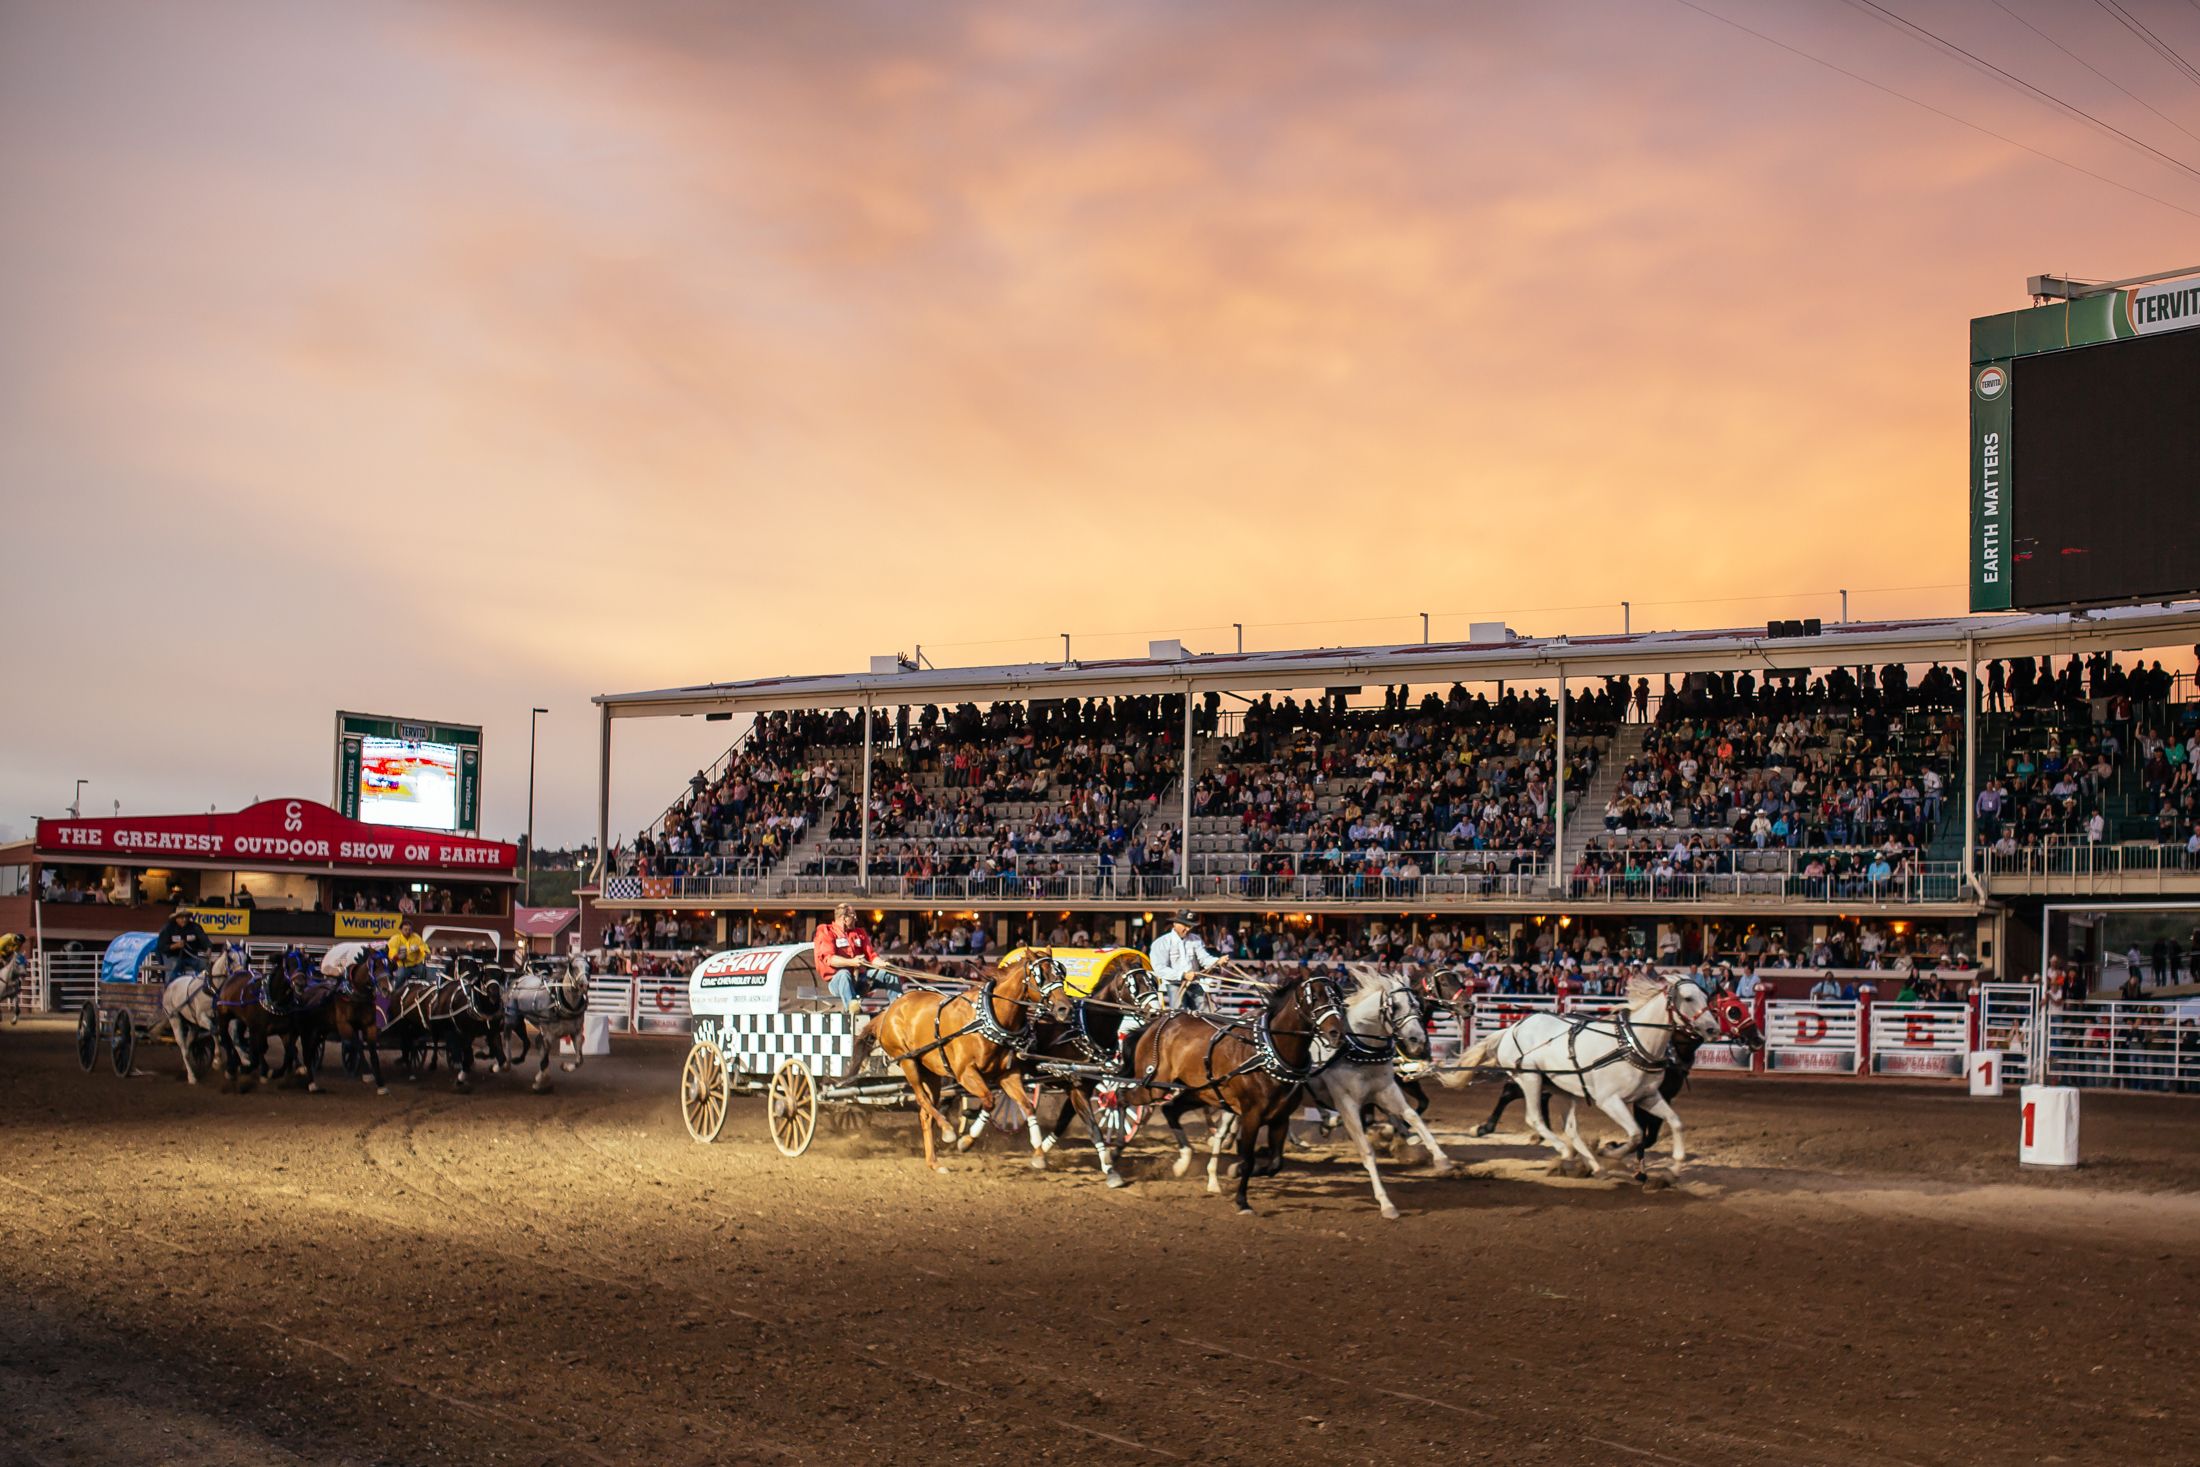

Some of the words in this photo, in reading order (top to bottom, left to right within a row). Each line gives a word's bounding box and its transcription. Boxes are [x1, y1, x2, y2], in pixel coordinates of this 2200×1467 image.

[1981, 378, 2001, 389] TERVITA
[1983, 432, 1999, 517] MATTERS
[1983, 523, 1999, 584] EARTH
[401, 725, 426, 738] TERVITA
[464, 776, 473, 822] tervita.com
[58, 827, 102, 846] THE
[113, 830, 223, 851] GREATEST
[234, 836, 330, 857] OUTDOOR
[339, 841, 395, 860] SHOW
[404, 844, 430, 861] ON
[439, 846, 500, 864] EARTH
[341, 914, 396, 934] Wrangler
[705, 951, 779, 974] SHAW
[717, 976, 751, 986] CHEVROLET
[655, 986, 676, 1012] C
[1794, 1011, 1828, 1044] D
[1903, 1014, 1935, 1046] E
[1978, 1061, 1993, 1087] 1
[2021, 1102, 2036, 1148] 1
